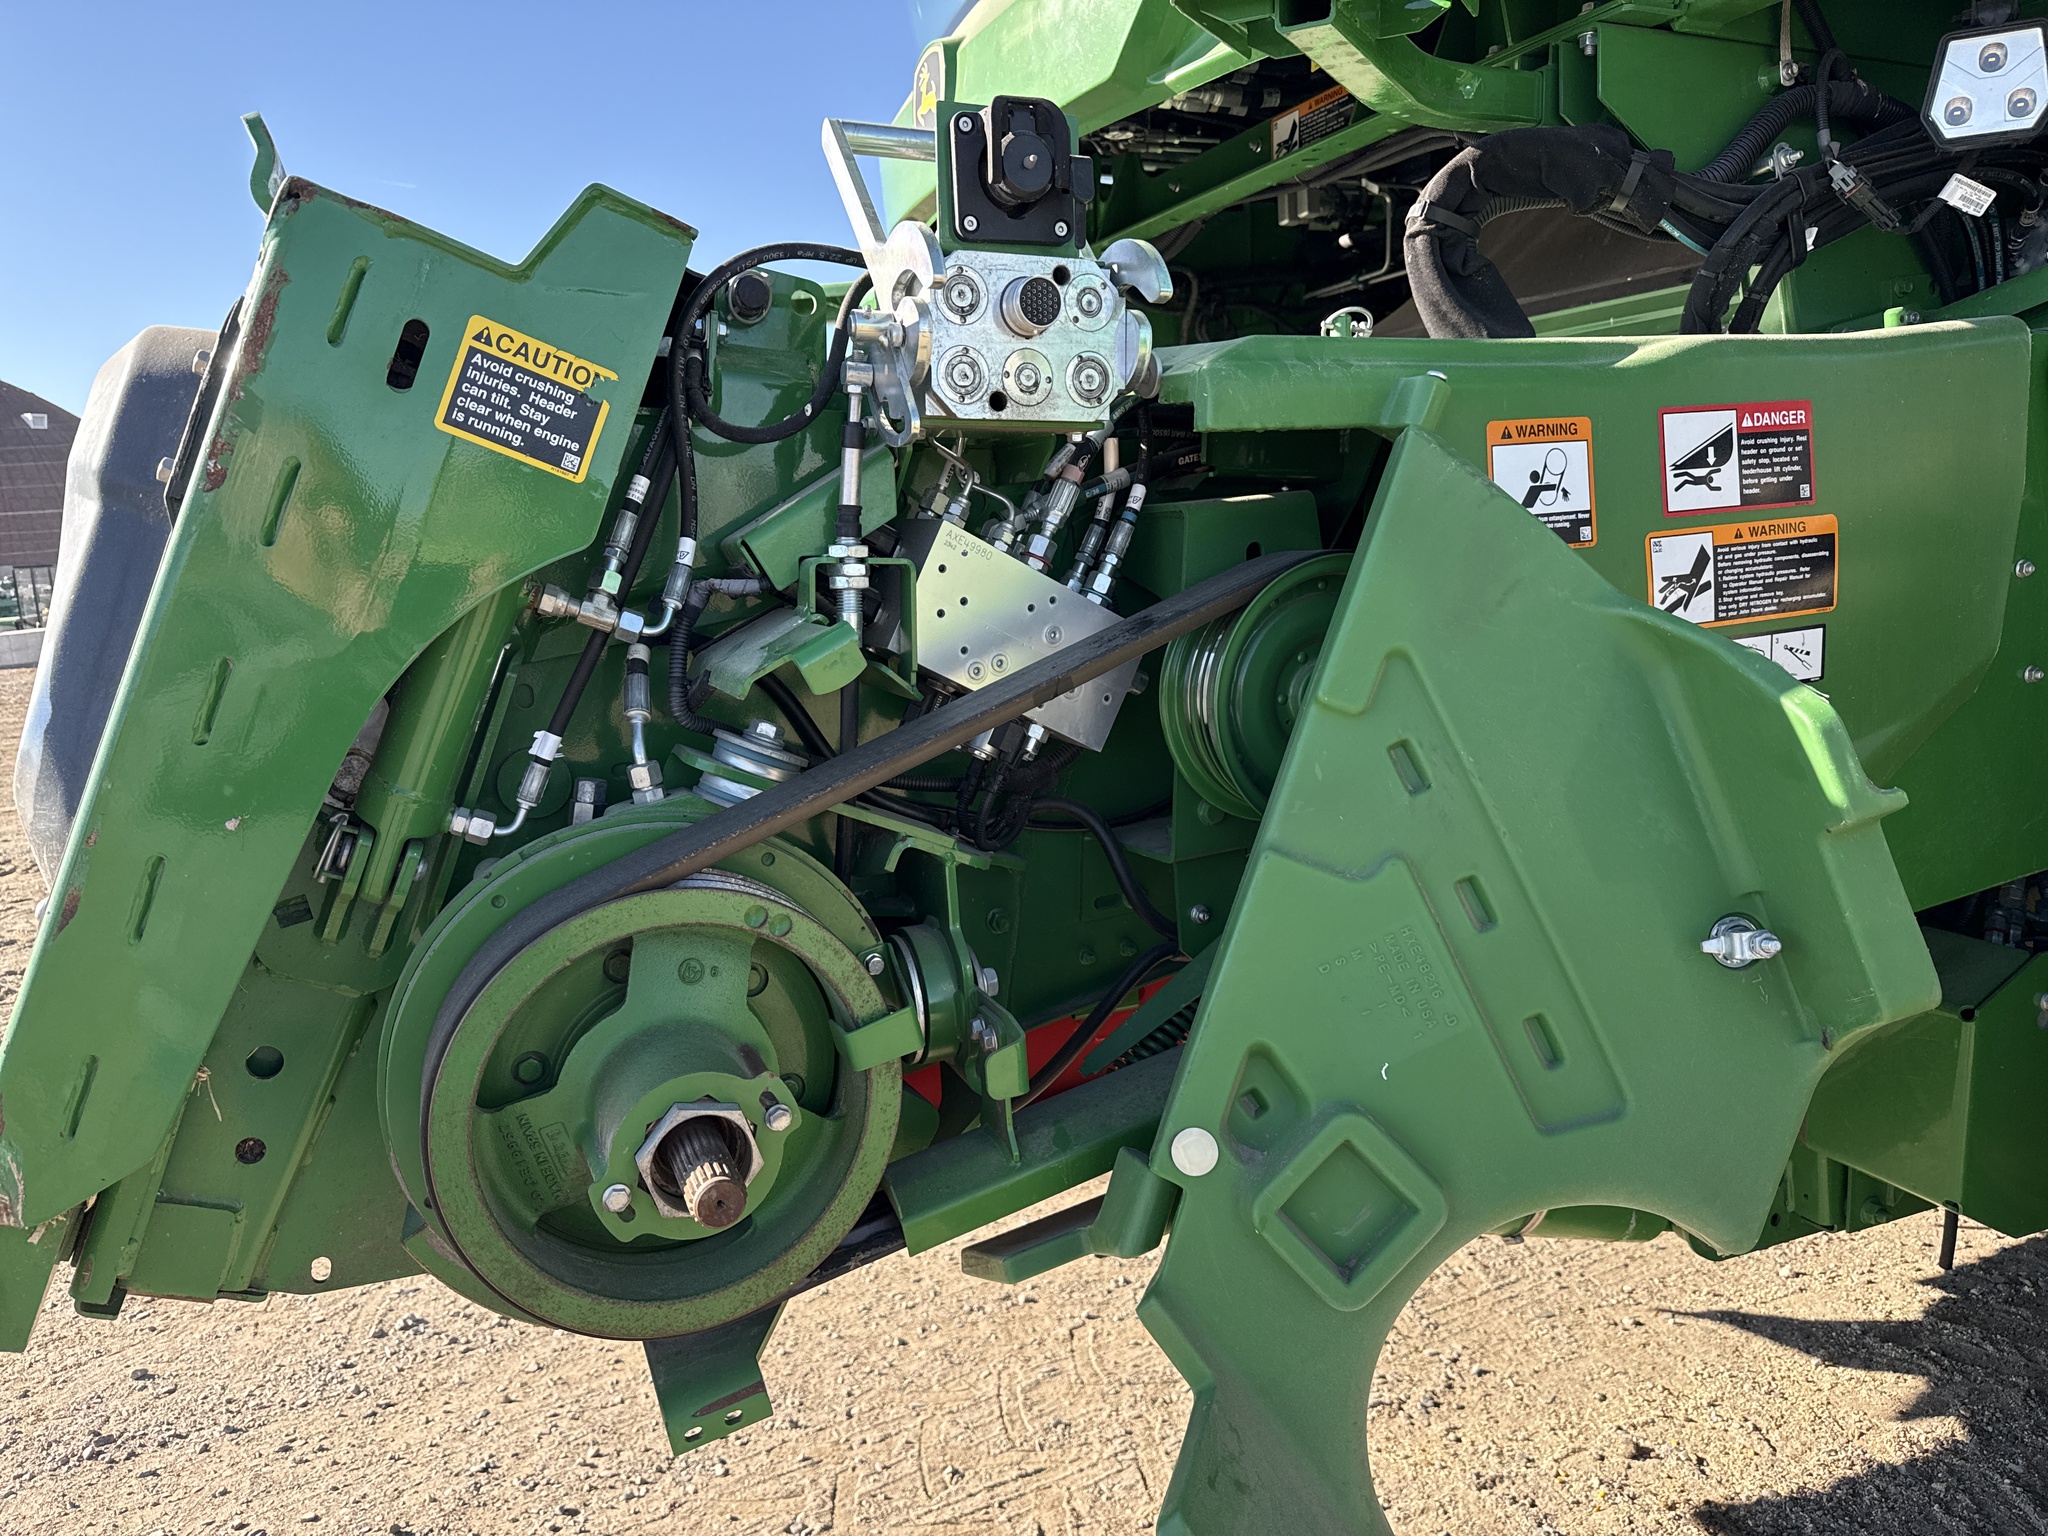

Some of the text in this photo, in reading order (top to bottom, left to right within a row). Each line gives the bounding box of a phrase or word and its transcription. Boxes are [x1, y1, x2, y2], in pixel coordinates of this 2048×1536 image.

[1314, 88, 1343, 107] WARNING
[701, 272, 731, 305] exceeds
[496, 333, 600, 385] CAUTIO
[467, 367, 577, 419] injuries. Header
[471, 353, 575, 405] Avoid crushing
[462, 383, 550, 426] can tilt. Stay
[1754, 410, 1806, 426] DANGER
[452, 408, 524, 446] is running.
[457, 396, 580, 451] clear when engine
[1516, 423, 1578, 438] WARNING
[1769, 446, 1785, 454] ground
[1782, 465, 1802, 473] cylinder,
[945, 530, 993, 561] AXE49980
[1749, 522, 1806, 537] WARNING
[710, 965, 719, 978] 6
[1400, 926, 1442, 998] HXE48216
[1384, 934, 1438, 1028] MADE IN USA
[516, 1113, 542, 1152] SPAIN
[541, 1166, 564, 1201] MADE
